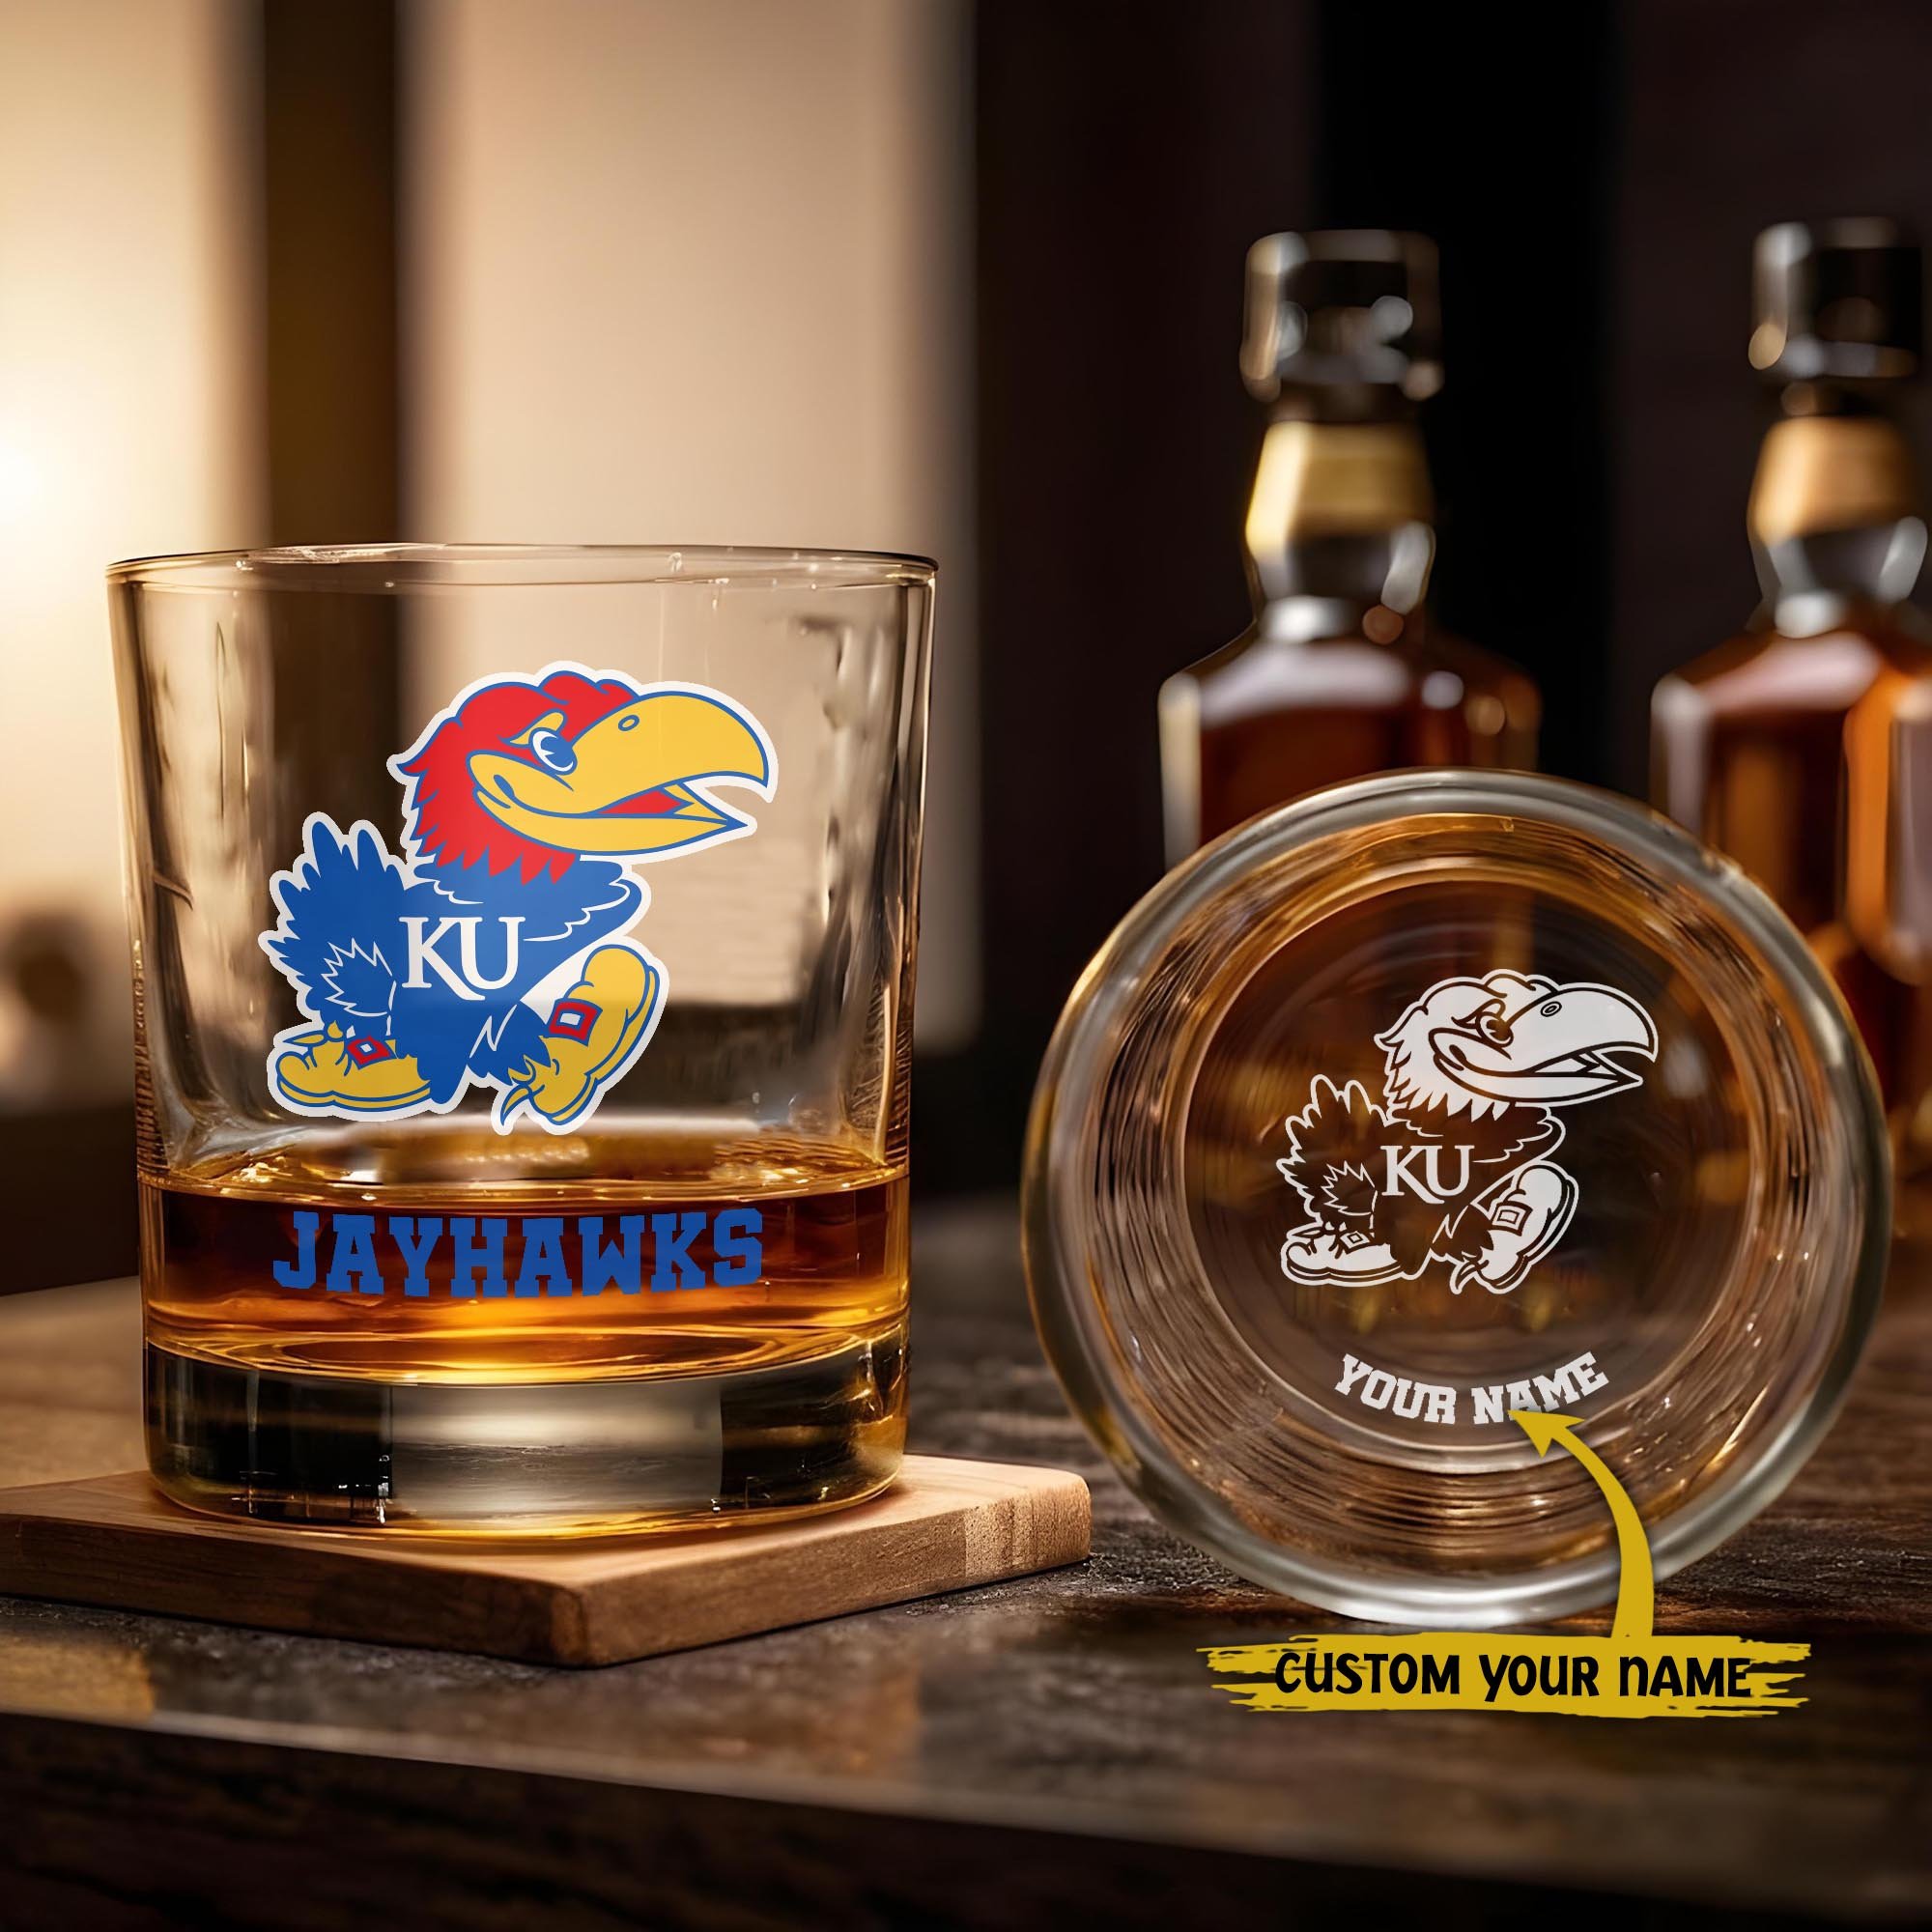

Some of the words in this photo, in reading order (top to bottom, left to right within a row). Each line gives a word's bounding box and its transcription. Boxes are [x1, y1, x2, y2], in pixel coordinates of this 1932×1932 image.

[399, 917, 526, 1001] KU
[1380, 1145, 1474, 1205] KU
[272, 1208, 763, 1298] JAYHAWKS
[1334, 1353, 1457, 1425] YOUR
[1470, 1351, 1609, 1425] NAME
